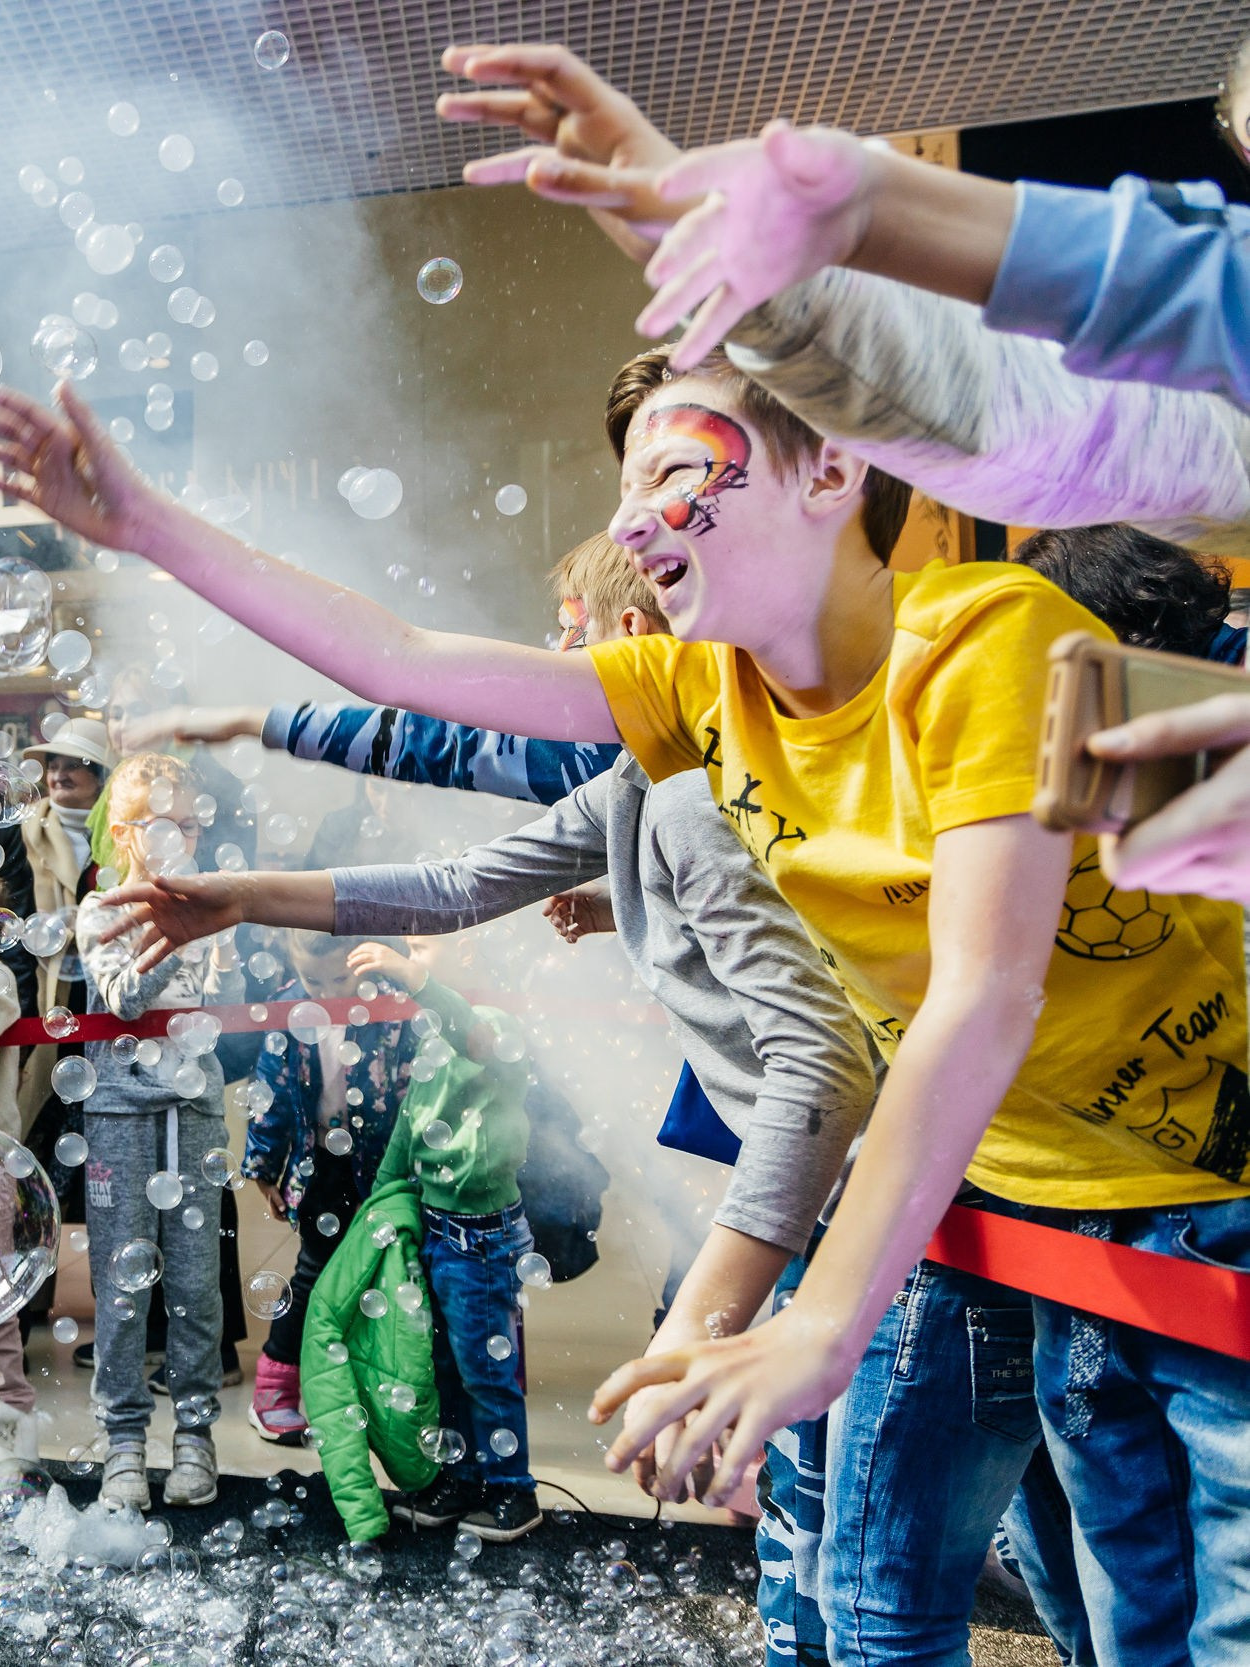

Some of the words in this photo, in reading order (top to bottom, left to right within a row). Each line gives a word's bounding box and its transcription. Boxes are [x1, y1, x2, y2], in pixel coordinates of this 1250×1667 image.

[1140, 991, 1229, 1060] Team
[1152, 1116, 1197, 1150] GJ
[88, 1180, 112, 1195] STAY
[91, 1194, 116, 1208] COOL
